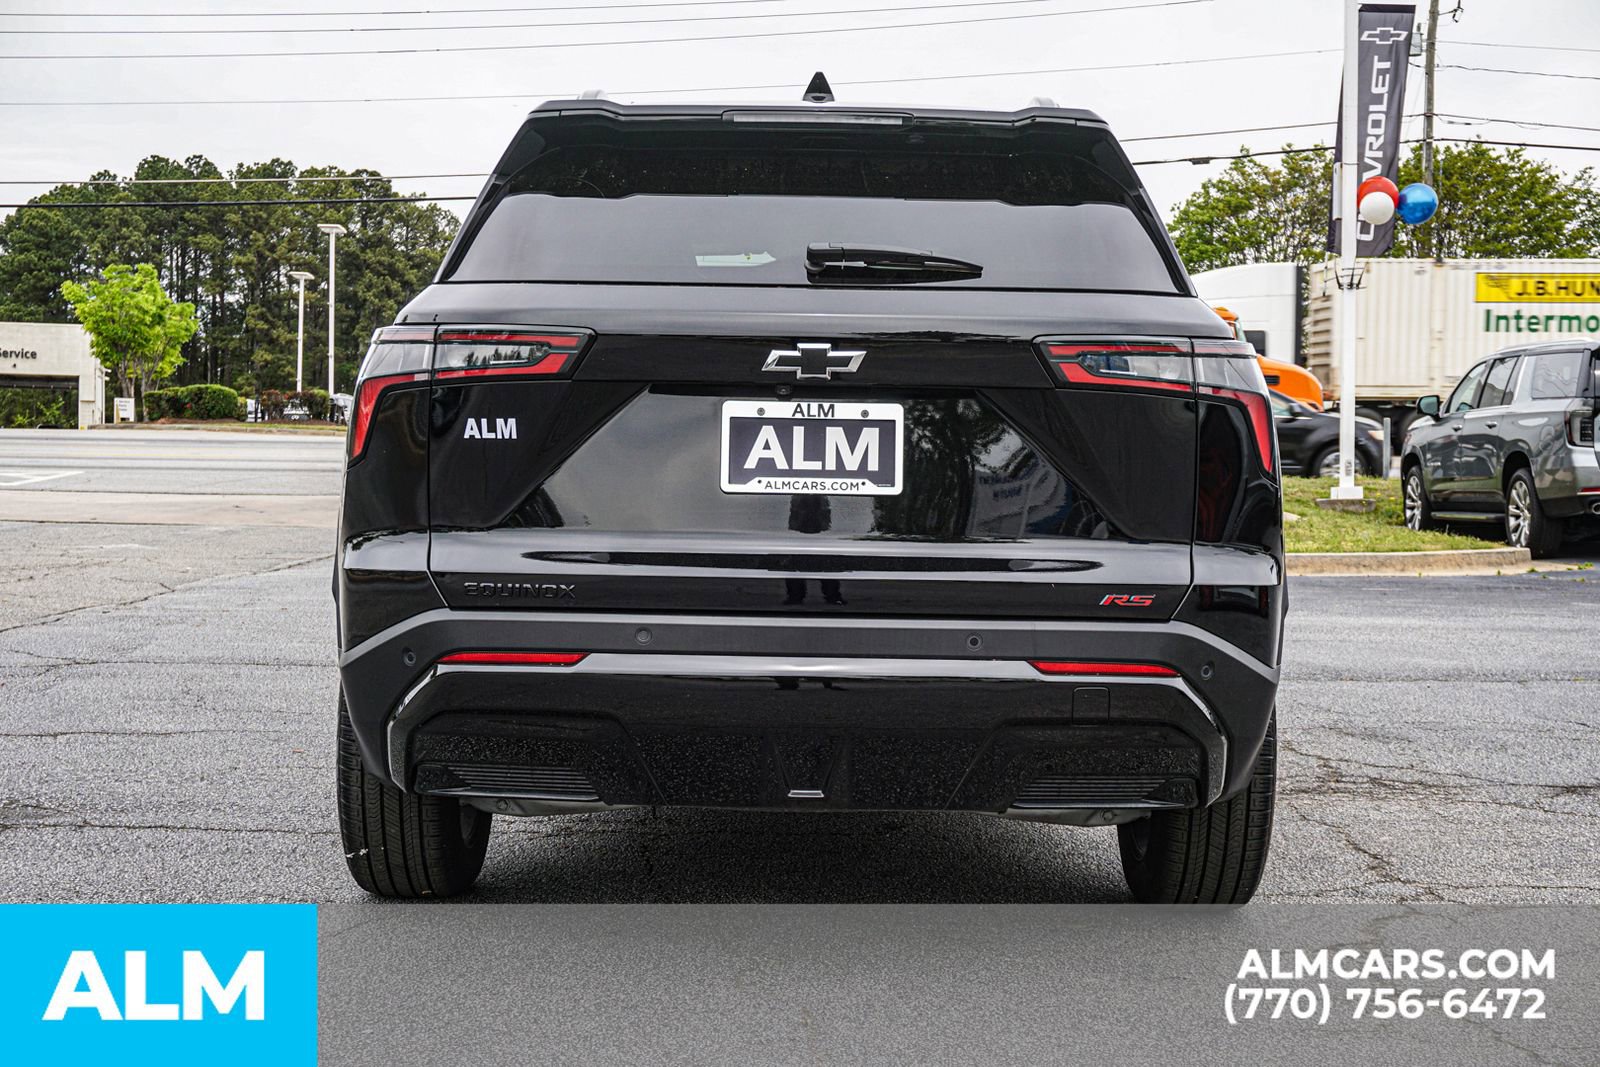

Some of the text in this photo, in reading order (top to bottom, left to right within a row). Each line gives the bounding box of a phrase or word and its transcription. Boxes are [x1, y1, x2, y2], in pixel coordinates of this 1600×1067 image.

[1356, 55, 1392, 241] CVROLET
[1484, 309, 1600, 333] Intermo
[0, 347, 37, 360] ervice
[791, 403, 835, 418] ALM
[463, 417, 518, 440] ALM
[743, 425, 880, 472] ALM
[764, 481, 860, 492] ALMCARS.COM
[463, 581, 577, 600] EQUINOX
[1099, 593, 1156, 607] RS
